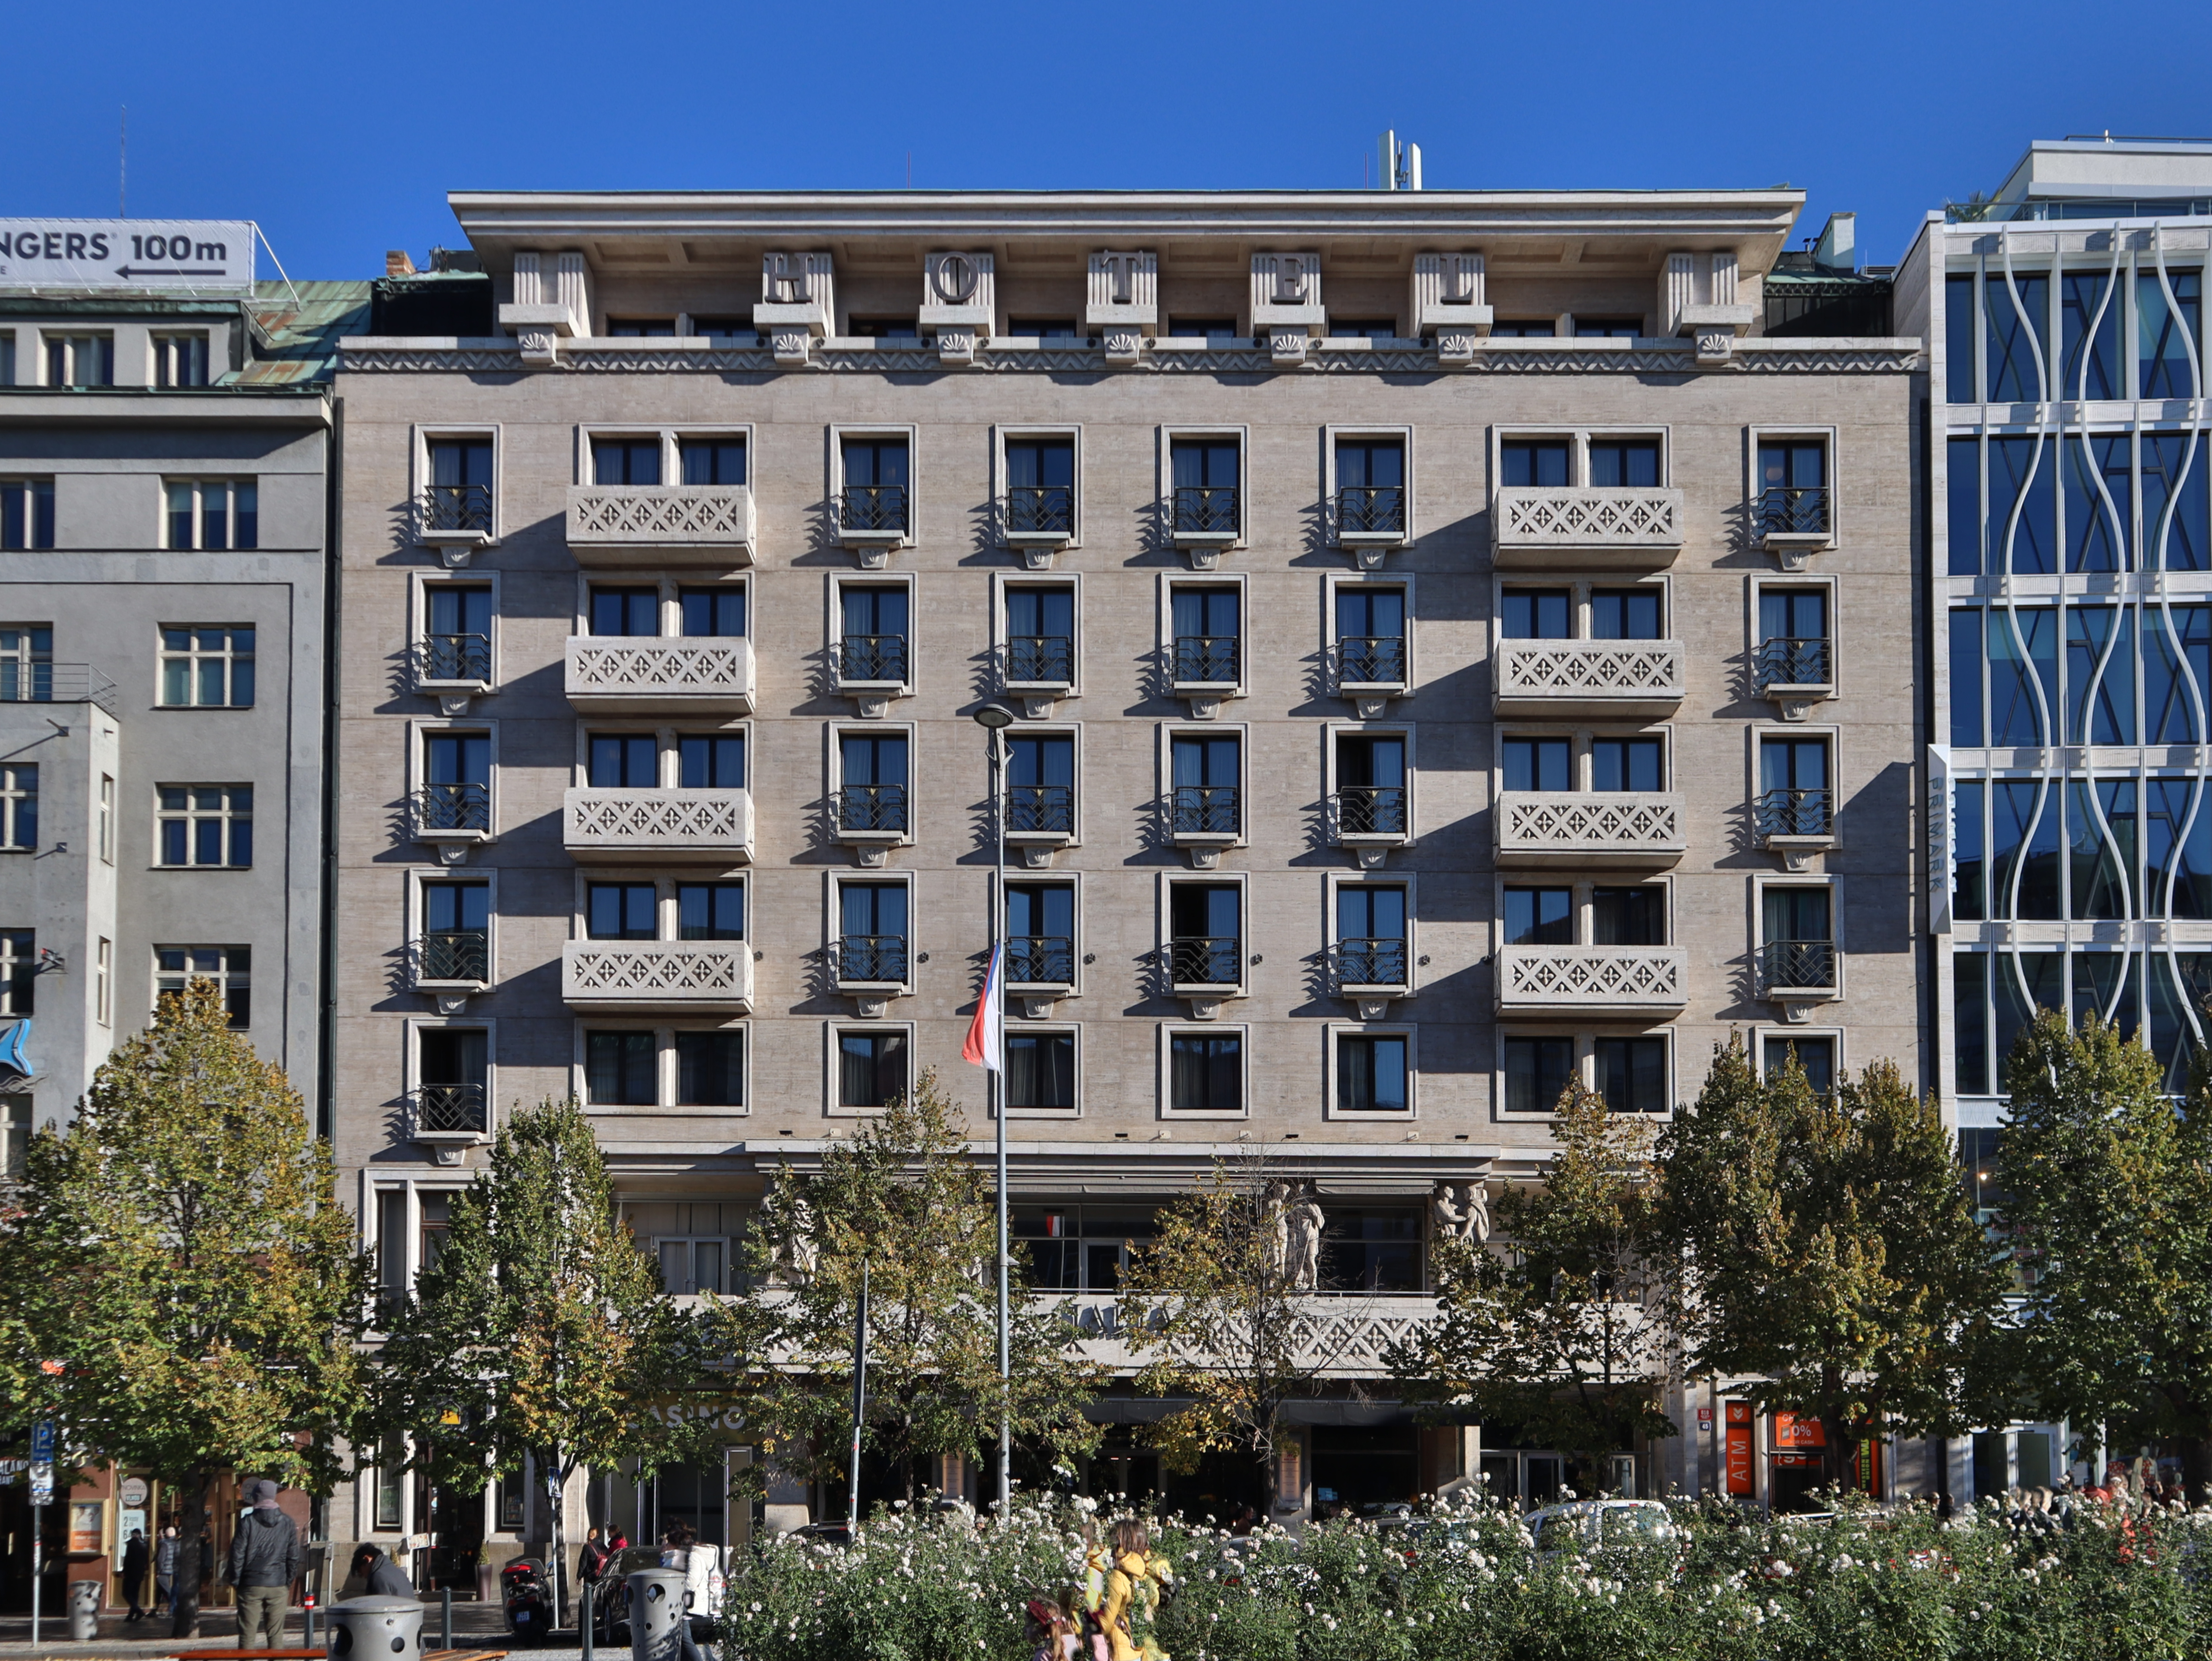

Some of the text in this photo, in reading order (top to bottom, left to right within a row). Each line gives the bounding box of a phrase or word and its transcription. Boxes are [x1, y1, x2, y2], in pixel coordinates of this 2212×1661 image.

[36, 1426, 49, 1449] P
[1792, 1425, 1812, 1437] 0%
[1731, 1440, 1747, 1481] ATM
[124, 1516, 128, 1527] 2
